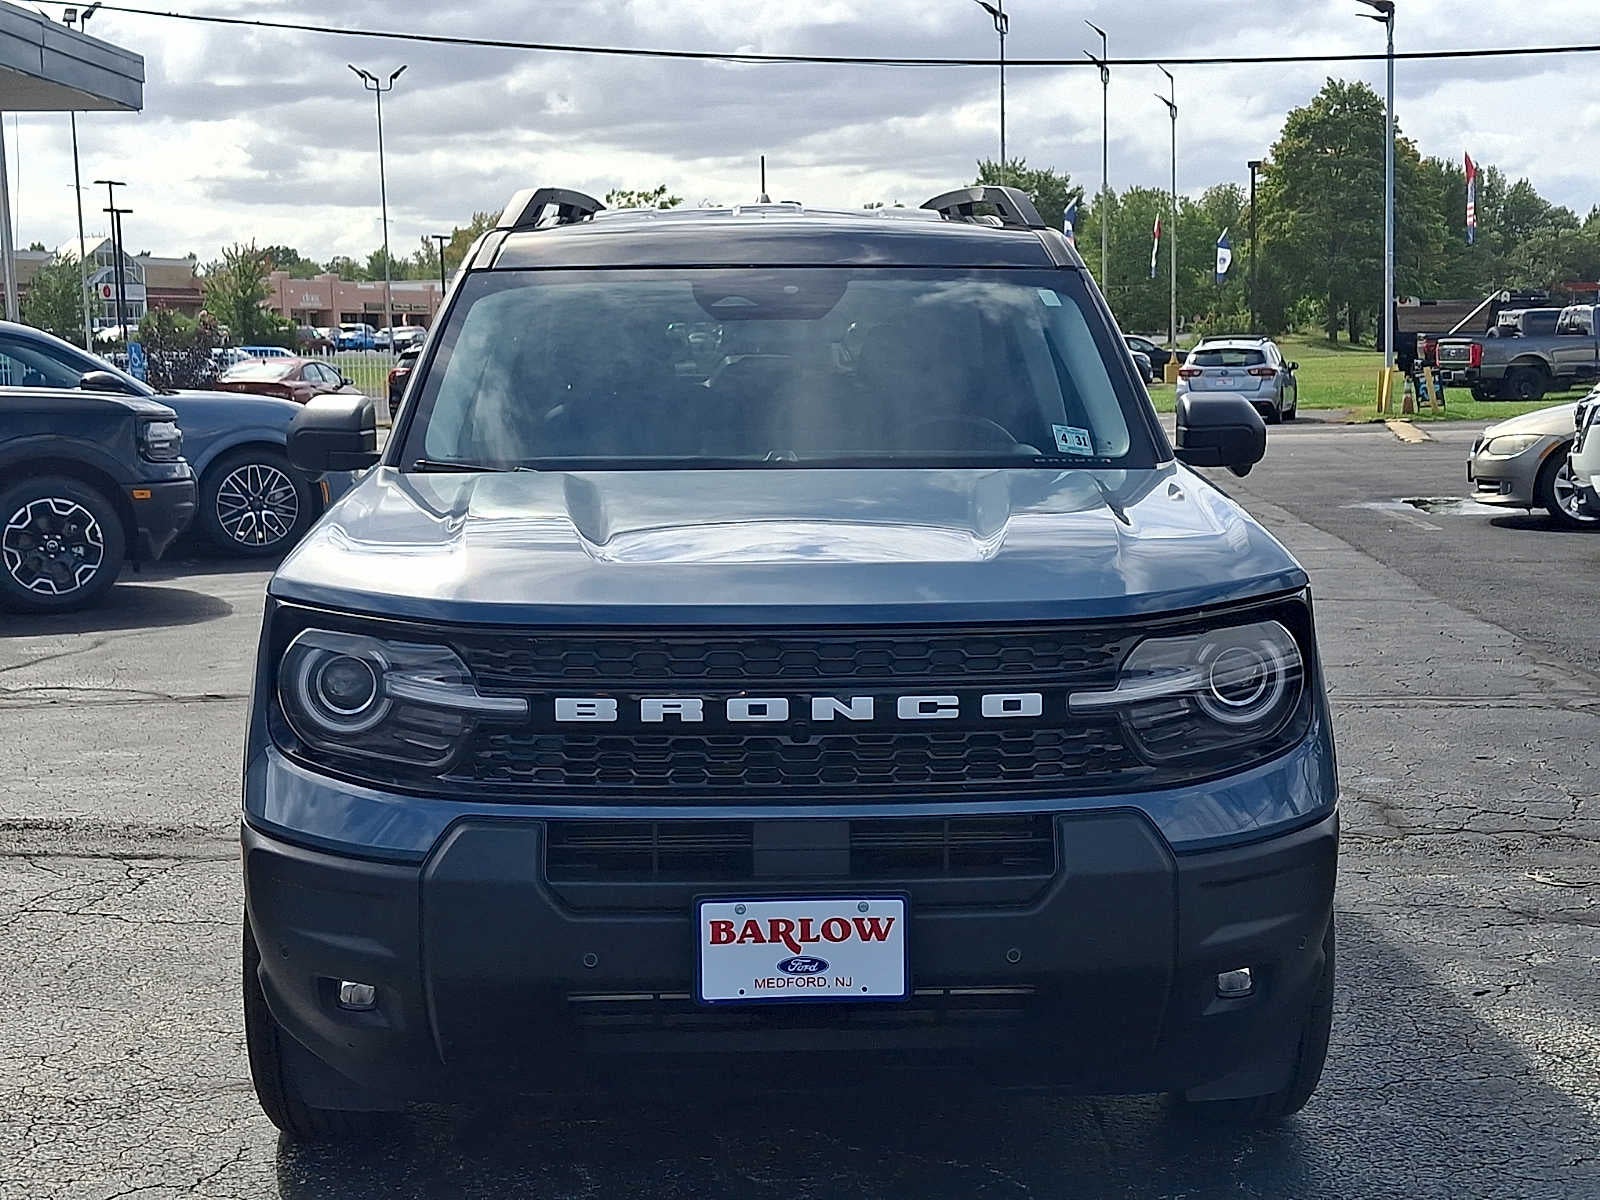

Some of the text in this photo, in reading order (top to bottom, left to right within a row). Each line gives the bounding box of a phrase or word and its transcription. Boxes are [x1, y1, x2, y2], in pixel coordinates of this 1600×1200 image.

[1061, 433, 1088, 447] 4 31
[555, 693, 1043, 722] BRONCO
[709, 917, 895, 955] BARLOW
[787, 957, 820, 973] Ford
[754, 977, 853, 989] MEDFORD, NJ
